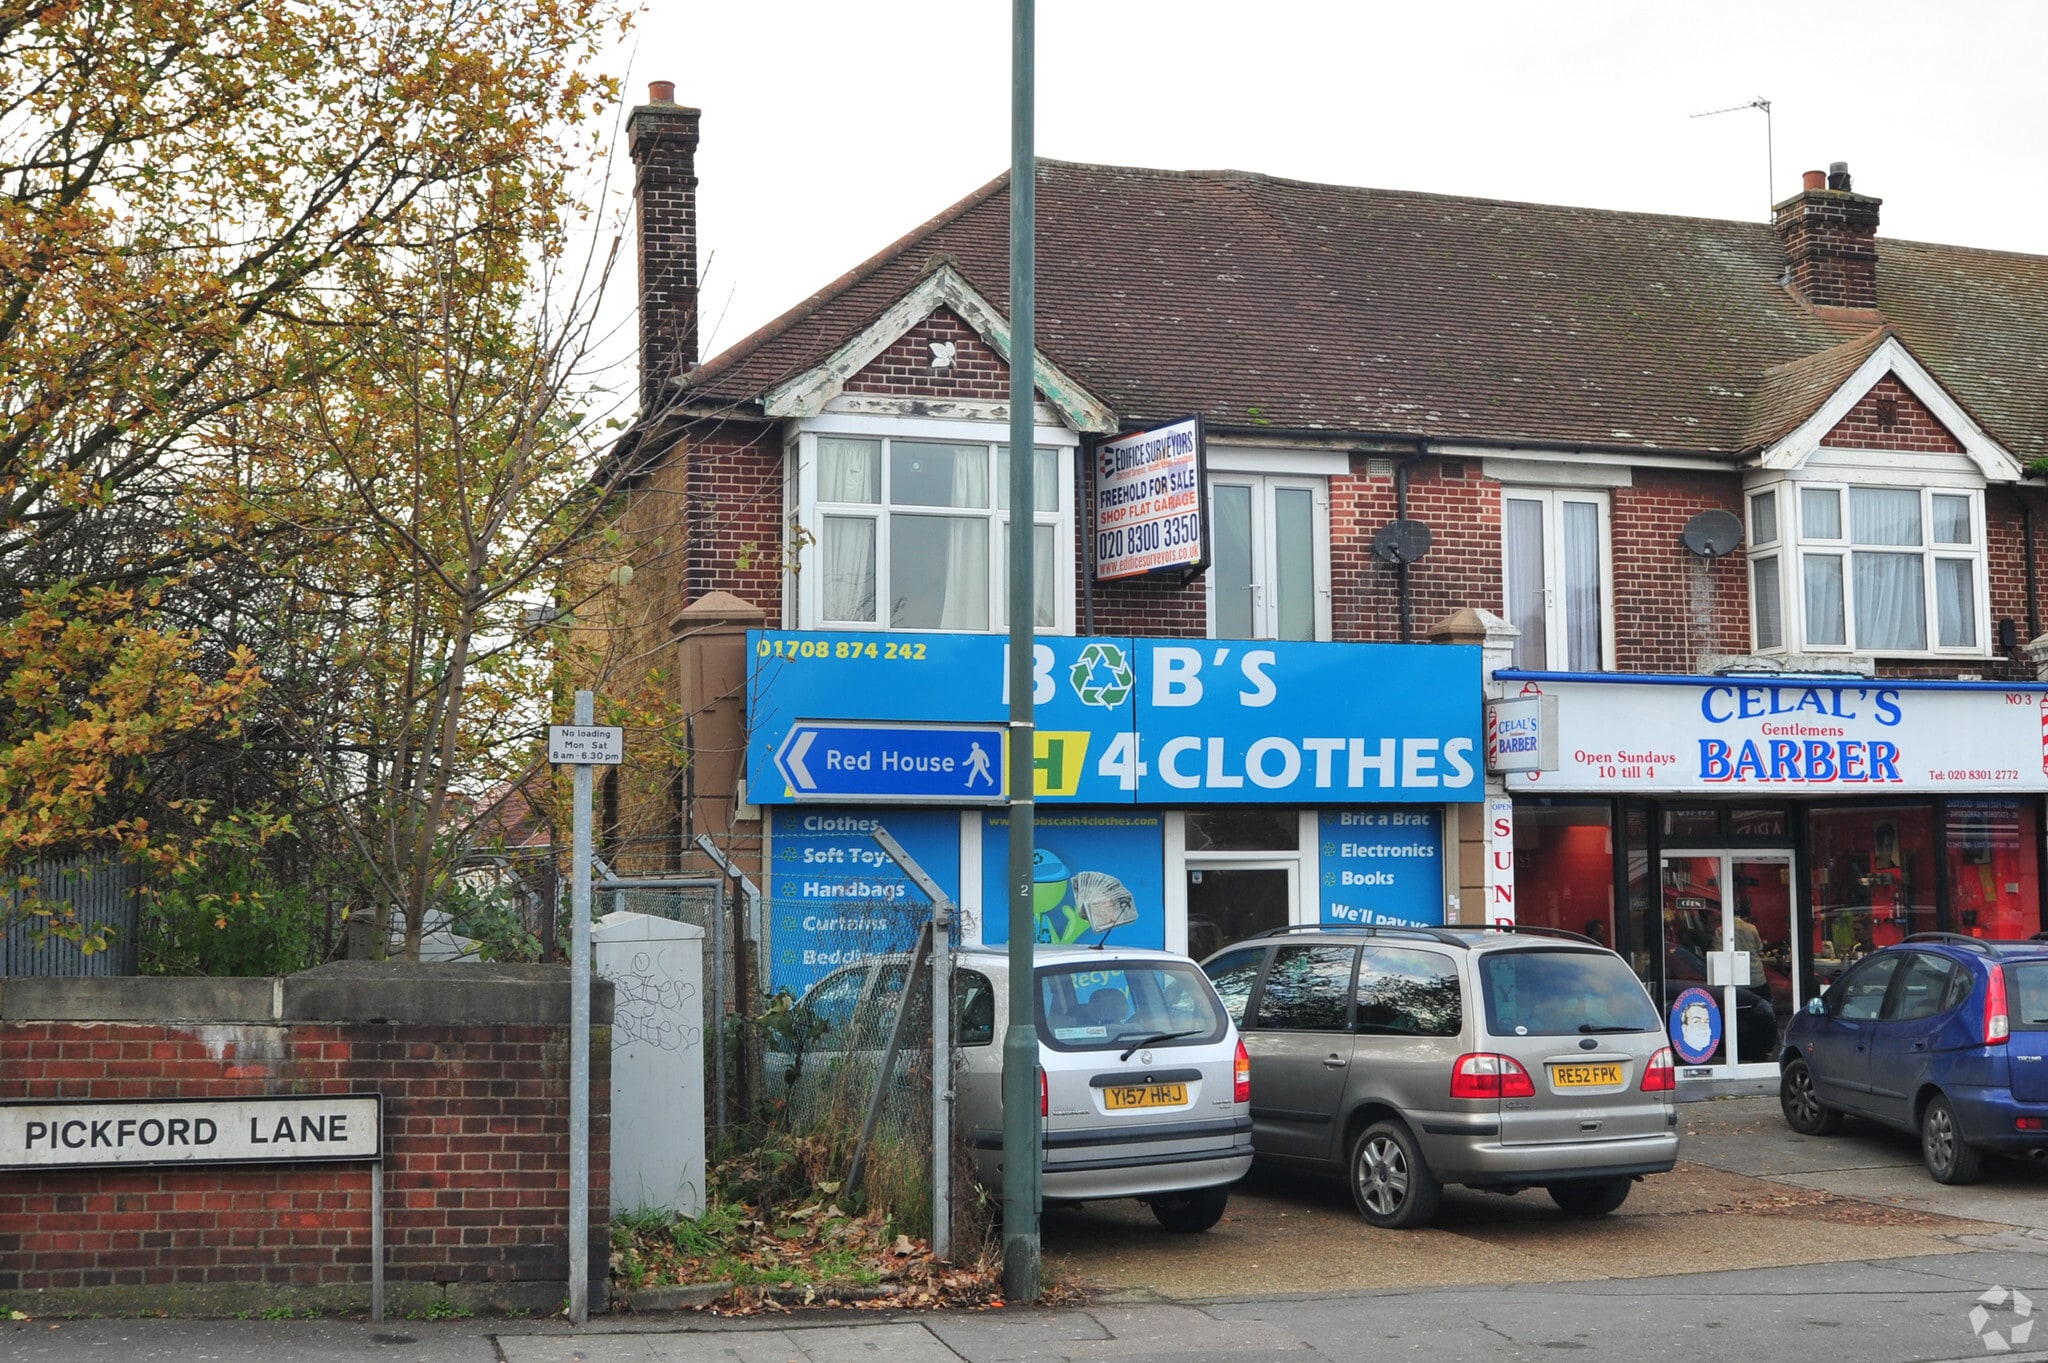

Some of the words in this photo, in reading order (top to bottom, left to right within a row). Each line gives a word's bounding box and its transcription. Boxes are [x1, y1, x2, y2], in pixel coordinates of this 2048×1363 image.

[1115, 443, 1145, 472] EDIFICE
[1145, 431, 1193, 464] SURVEYORS
[1100, 481, 1147, 509] FREEHOLD
[1149, 475, 1168, 497] FOR
[1171, 469, 1195, 492] SALE
[1100, 508, 1126, 524] SHOP
[1129, 501, 1151, 519] FLAT
[1154, 491, 1196, 512] GARAGE
[1099, 531, 1123, 561] 020
[1127, 521, 1159, 555] 8300
[1163, 513, 1198, 547] 3350
[1099, 543, 1198, 575] www.edificesurveyors.co.uk
[757, 639, 829, 659] 01708
[835, 641, 879, 659] 874
[884, 642, 926, 660] 242
[1701, 686, 1903, 727] CELAL'S
[2005, 693, 2023, 705] NO
[2025, 693, 2032, 705] 3
[562, 729, 575, 737] No
[577, 729, 611, 739] loading
[1498, 717, 1537, 734] CELAL'S
[1761, 722, 1844, 737] Gentlemens
[565, 741, 584, 749] Mon
[591, 741, 607, 750] Sat
[1498, 736, 1537, 753] BARBER
[552, 751, 559, 759] 8
[581, 751, 603, 760] 6.30
[605, 753, 619, 761] pm
[826, 751, 871, 771] Red
[882, 751, 955, 773] House
[1099, 732, 1147, 790] 4
[1158, 736, 1474, 789] CLOTHES
[1574, 749, 1612, 765] Open
[1617, 750, 1676, 766] Sundays
[1698, 739, 1903, 783] BARBER
[1599, 765, 1616, 778] 10
[1621, 765, 1641, 778] till
[1645, 765, 1655, 778] 4
[1947, 770, 1966, 780] 020
[1968, 770, 1992, 780] 8301
[1994, 770, 2018, 780] 2772
[1491, 803, 1511, 812] OPEN
[803, 816, 879, 831] Clothes
[989, 816, 1158, 827] wwobscash4clothes.com
[1341, 812, 1373, 826] Bric
[1378, 814, 1388, 826] a
[1393, 812, 1430, 826] Brac
[803, 848, 844, 864] Soft
[1341, 843, 1434, 858] Electronics
[1341, 871, 1395, 886] Books
[803, 881, 905, 901] Handbags
[1020, 884, 1028, 897] 2
[1331, 903, 1373, 924] We'll
[802, 915, 887, 932] Curtains
[1558, 1068, 1591, 1083] RE52
[1594, 1067, 1617, 1082] FPK
[1112, 1088, 1146, 1105] Y157
[1151, 1085, 1182, 1103] HHJ
[25, 1117, 218, 1149] PICKFORD
[250, 1115, 348, 1144] LANE
